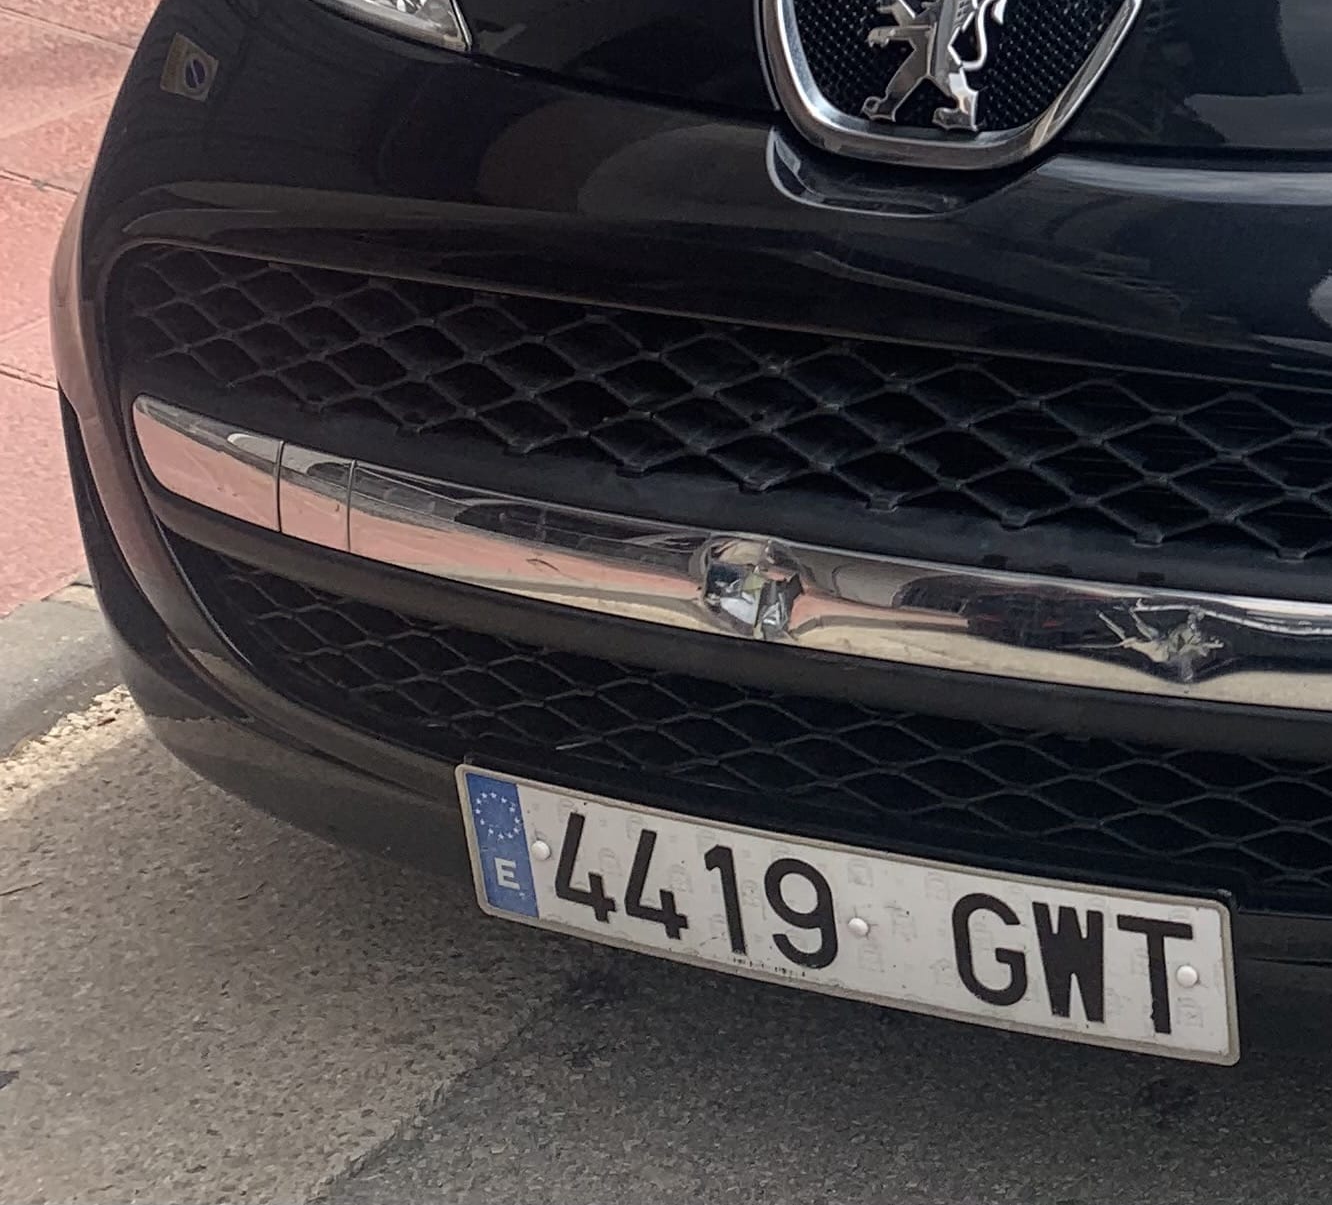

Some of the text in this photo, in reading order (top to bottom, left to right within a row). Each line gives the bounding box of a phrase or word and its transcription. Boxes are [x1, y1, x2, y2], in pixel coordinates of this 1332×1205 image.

[495, 859, 521, 890] E
[554, 812, 1193, 1035] 4419 GWT
